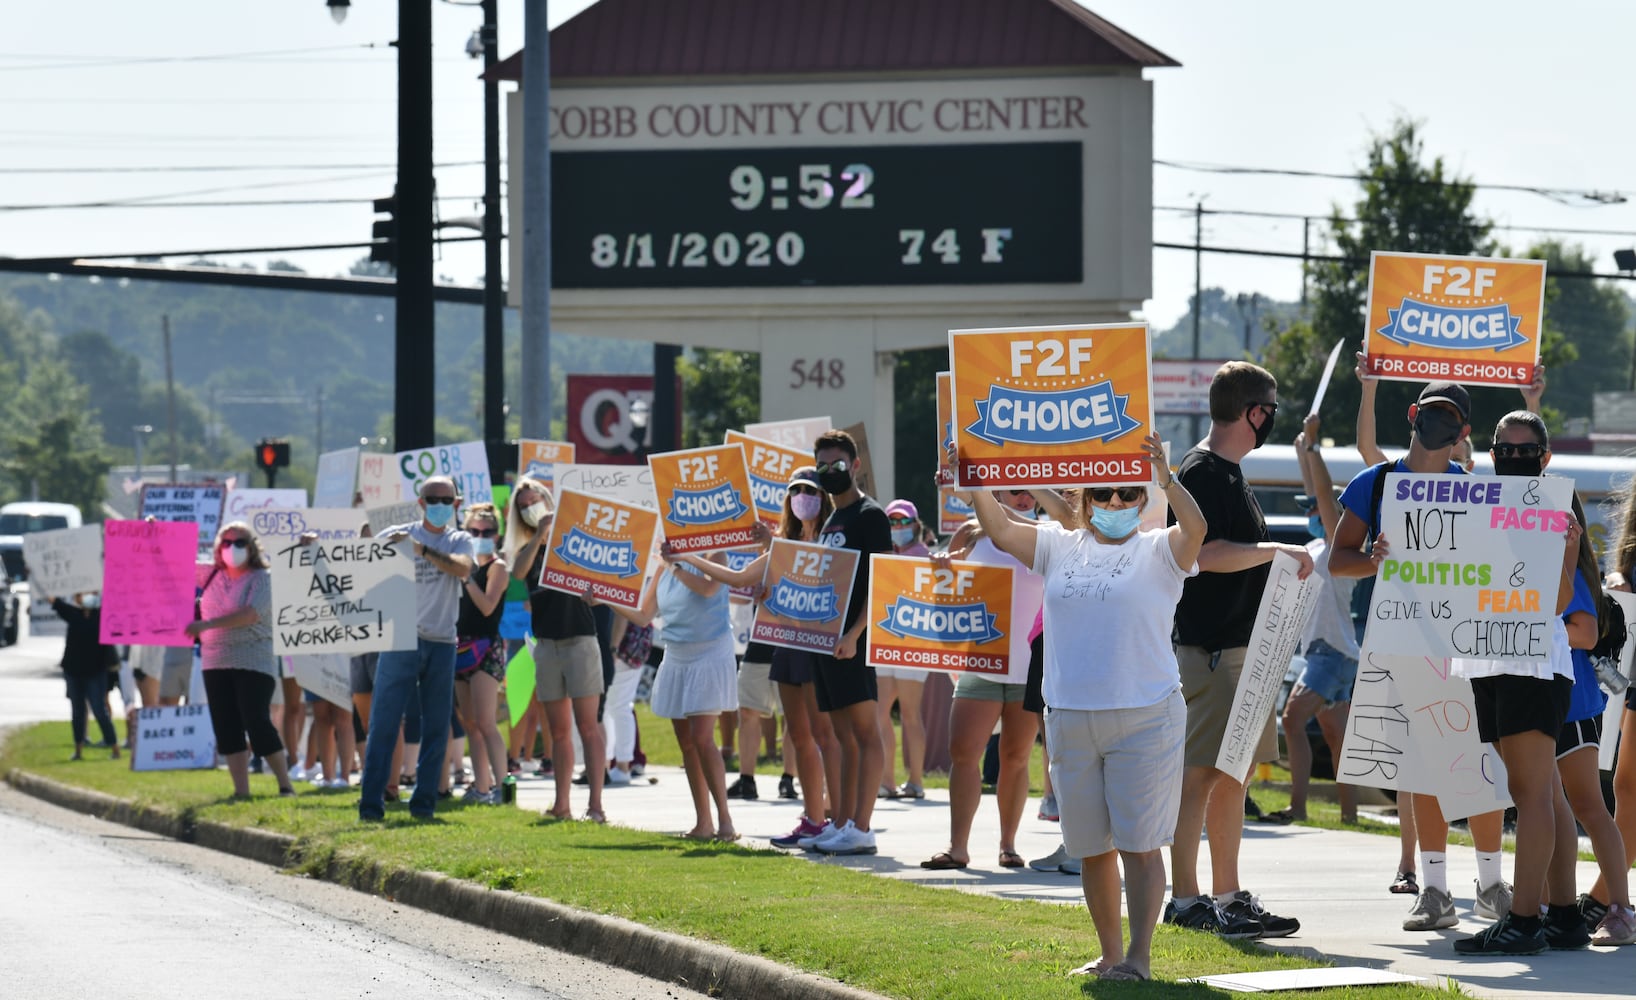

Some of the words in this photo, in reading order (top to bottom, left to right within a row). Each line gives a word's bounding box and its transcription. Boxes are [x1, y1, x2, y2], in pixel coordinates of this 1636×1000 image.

[648, 101, 811, 138] COUNTY
[817, 99, 924, 134] CIVIC
[933, 95, 1089, 132] CENTER
[729, 163, 875, 211] 9:52
[899, 228, 960, 264] 74
[981, 228, 1013, 263] F
[1423, 264, 1497, 297] F2F
[1400, 308, 1507, 340] CHOICE
[1010, 338, 1093, 377] F2F
[1374, 358, 1404, 373] FOR
[1407, 360, 1450, 375] COBB
[1453, 363, 1527, 380] SCHOOLS
[789, 358, 846, 390] 548
[991, 393, 1113, 431] CHOICE
[401, 446, 462, 480] COBB
[536, 444, 559, 459] F2F
[751, 445, 794, 476] F2F
[678, 455, 719, 483] F2F
[967, 464, 1001, 480] FOR
[1004, 462, 1054, 479] COBB
[1057, 459, 1142, 477] SCHOOLS
[675, 488, 736, 517] CHOICE
[750, 480, 786, 507] HOIC
[1396, 479, 1502, 505] SCIENCE
[1522, 479, 1541, 506] &
[584, 502, 630, 533] F2F
[1404, 508, 1467, 551] NOT
[1489, 506, 1569, 533] FACTS
[277, 541, 397, 569] TEACHERS
[567, 535, 629, 568] CHOICE
[670, 538, 688, 550] FOR
[689, 535, 713, 548] COBB
[792, 550, 833, 577] F2F
[1383, 559, 1492, 586] POLITICS
[1508, 561, 1526, 588] &
[307, 573, 353, 597] ARE
[546, 571, 564, 585] FOR
[592, 583, 635, 603] SCHOOLS
[914, 567, 975, 596] F2F
[277, 598, 373, 625] ESSENTIAL
[776, 585, 830, 612] CHOICE
[1376, 599, 1423, 620] GIVE
[1430, 599, 1452, 620] US
[1478, 589, 1541, 614] FEAR
[896, 605, 985, 633] CHOICE
[756, 625, 772, 638] FOR
[773, 628, 796, 641] COBB
[796, 632, 835, 648] SCHOOLS
[1451, 618, 1547, 658] CHOICE
[875, 648, 901, 661] FOR
[903, 651, 940, 664] COBB
[942, 654, 1003, 670] SCHOOLS
[1248, 657, 1265, 687] THE
[141, 708, 162, 719] GET
[175, 705, 203, 717] KIDS
[1414, 700, 1471, 739] TO
[144, 727, 175, 739] BACK
[183, 725, 195, 736] IN
[1343, 703, 1410, 780] YEAR
[153, 750, 194, 761] SCHOOL
